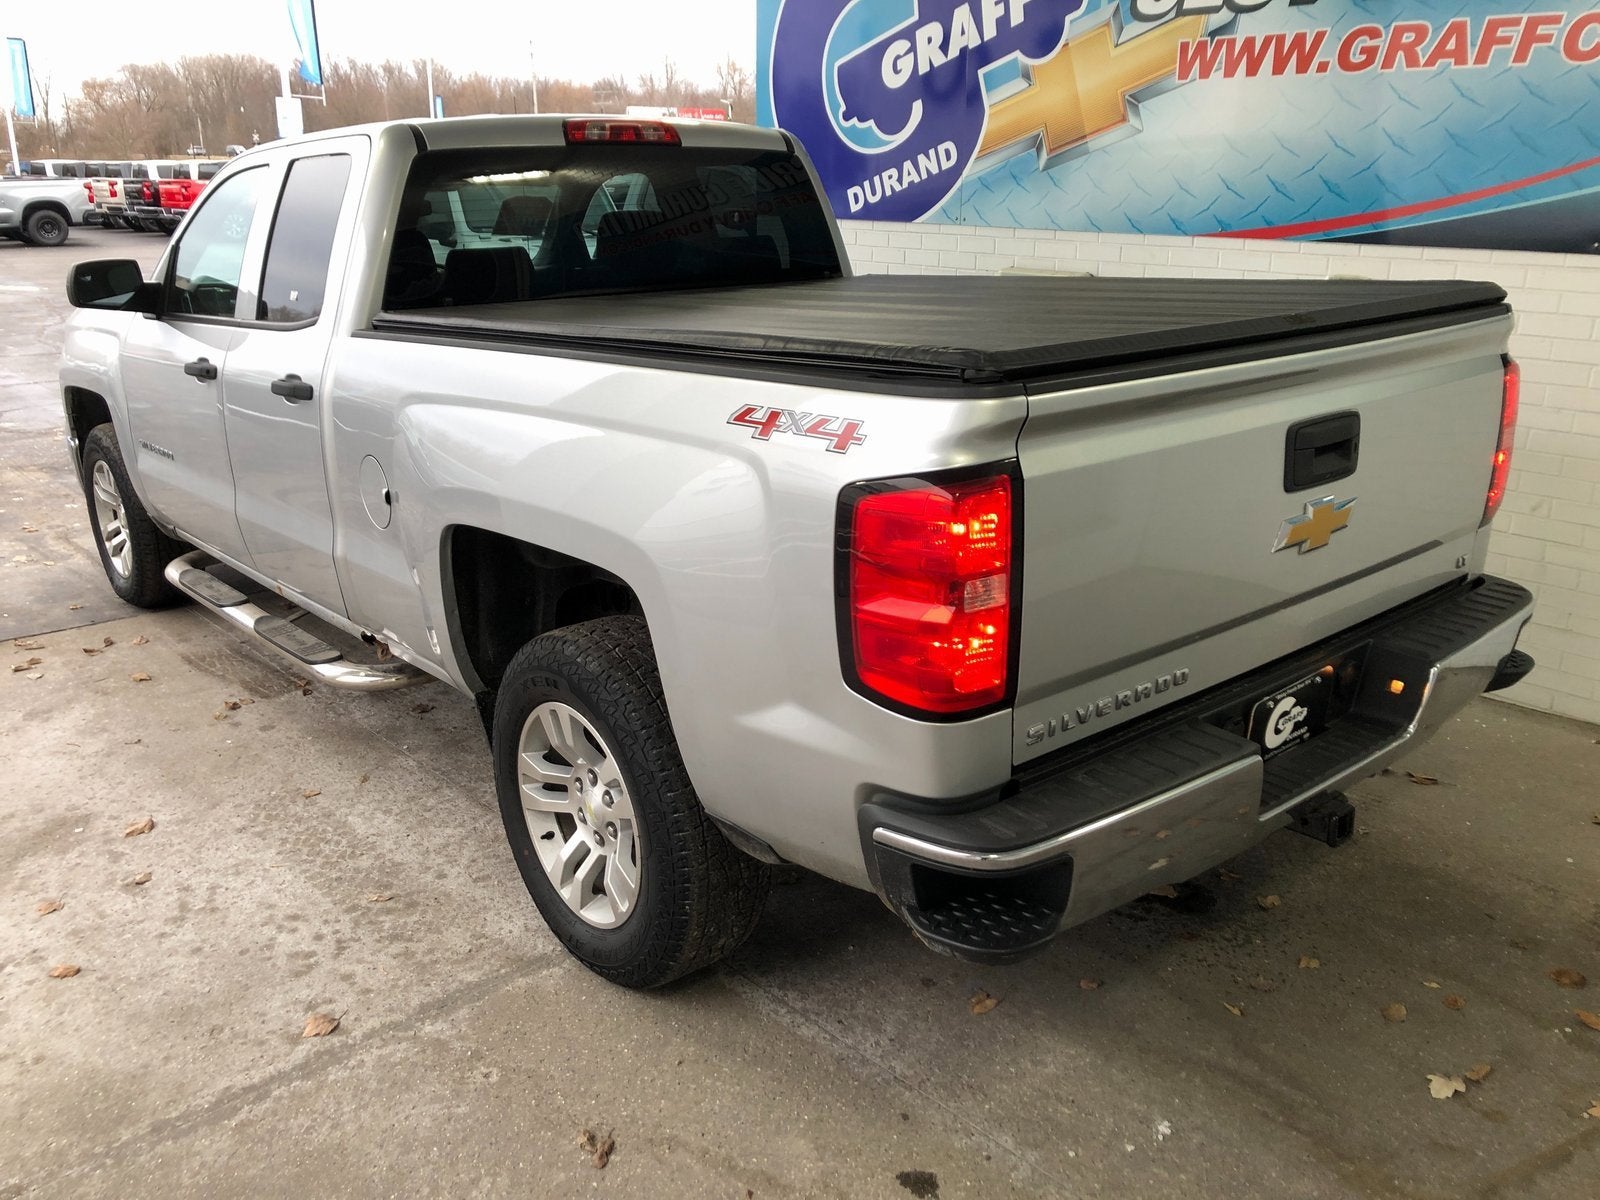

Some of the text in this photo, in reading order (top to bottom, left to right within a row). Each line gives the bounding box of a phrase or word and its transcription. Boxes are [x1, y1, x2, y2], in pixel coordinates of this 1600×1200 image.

[1176, 10, 1600, 82] WWW.GRAFFC
[846, 140, 958, 213] DURAND
[1026, 667, 1190, 747] SILVERADO
